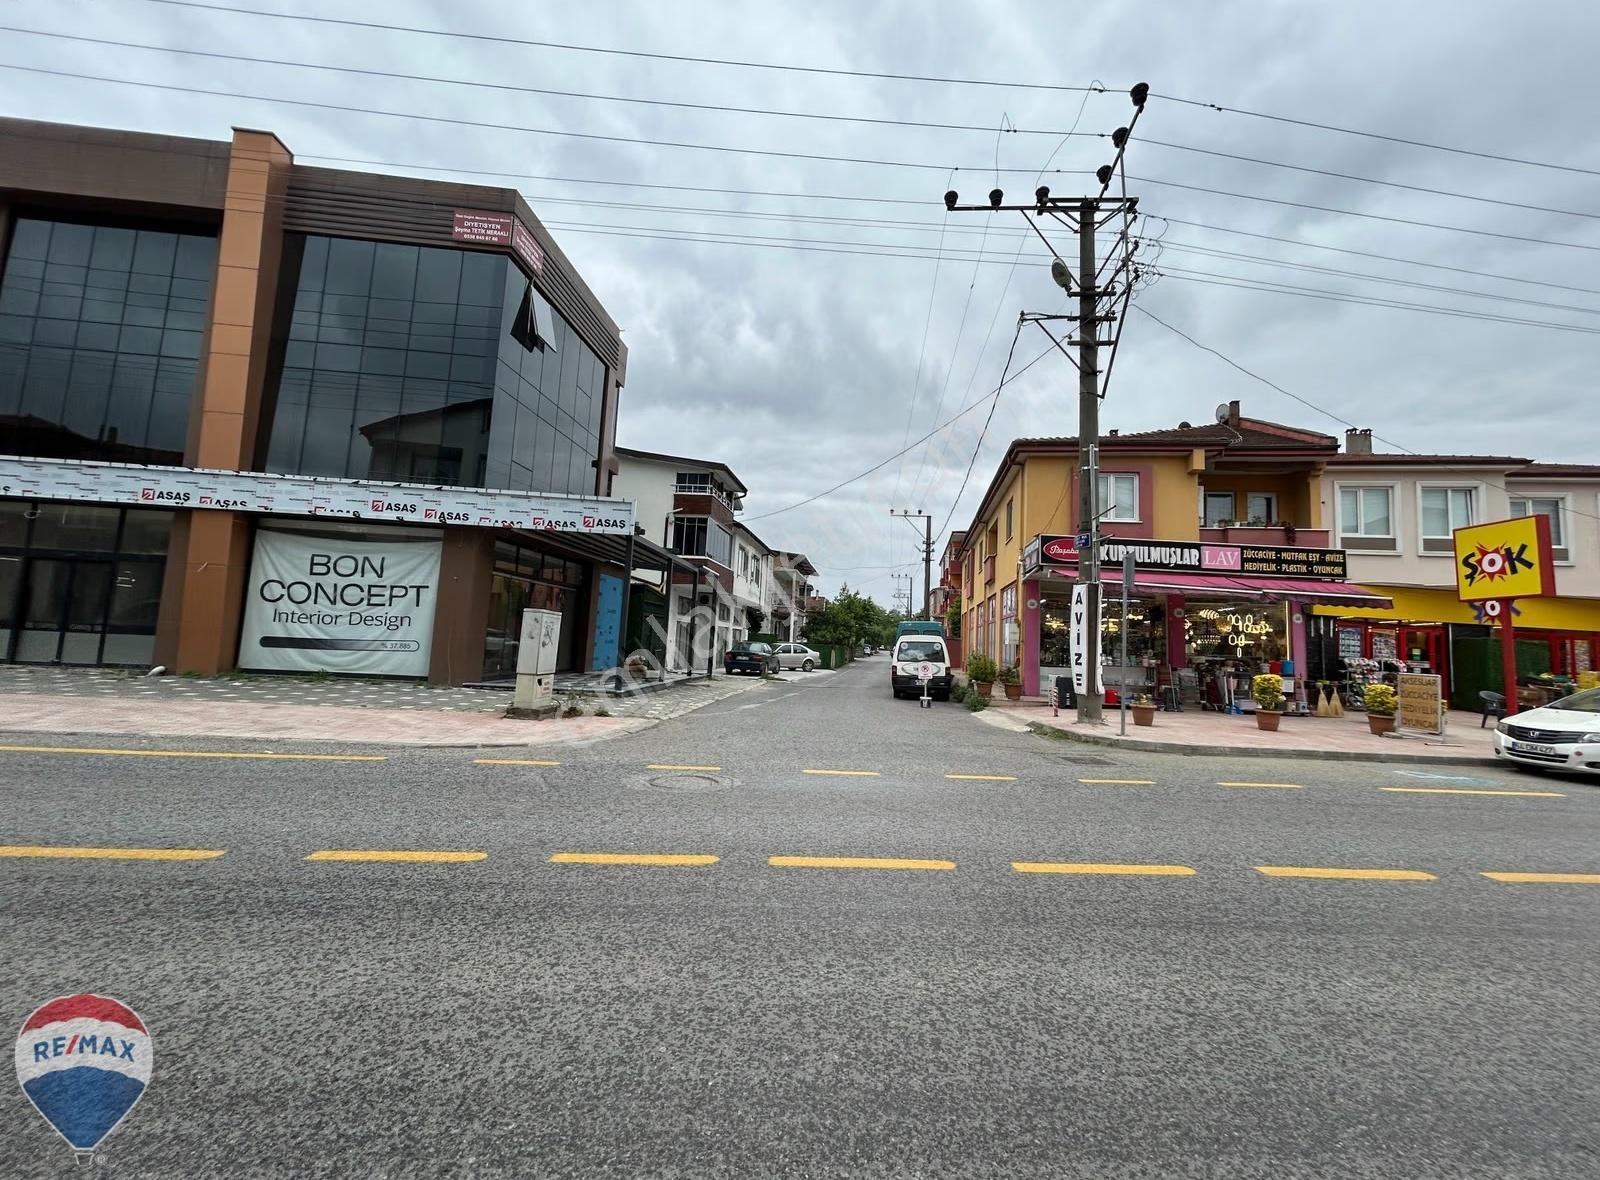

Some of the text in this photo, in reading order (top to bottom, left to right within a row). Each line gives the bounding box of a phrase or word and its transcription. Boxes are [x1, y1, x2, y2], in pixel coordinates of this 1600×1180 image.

[385, 502, 417, 514] ASAŞ
[596, 518, 626, 530] ASAŞ
[1203, 549, 1239, 566] LAV
[1243, 548, 1276, 559] ZÜCCACİYE
[1281, 551, 1307, 561] MUTFAK
[1325, 553, 1344, 562] AVİZE
[1461, 542, 1535, 588] ŞOK
[309, 553, 386, 579] BON
[1244, 561, 1277, 571] HEDİYELİK
[1281, 563, 1307, 573] PLASTİK
[1312, 565, 1343, 575] OYUNCAK
[259, 579, 430, 608] CONCEPT
[272, 608, 412, 631] Interior Design
[1074, 591, 1084, 687] AVİZE
